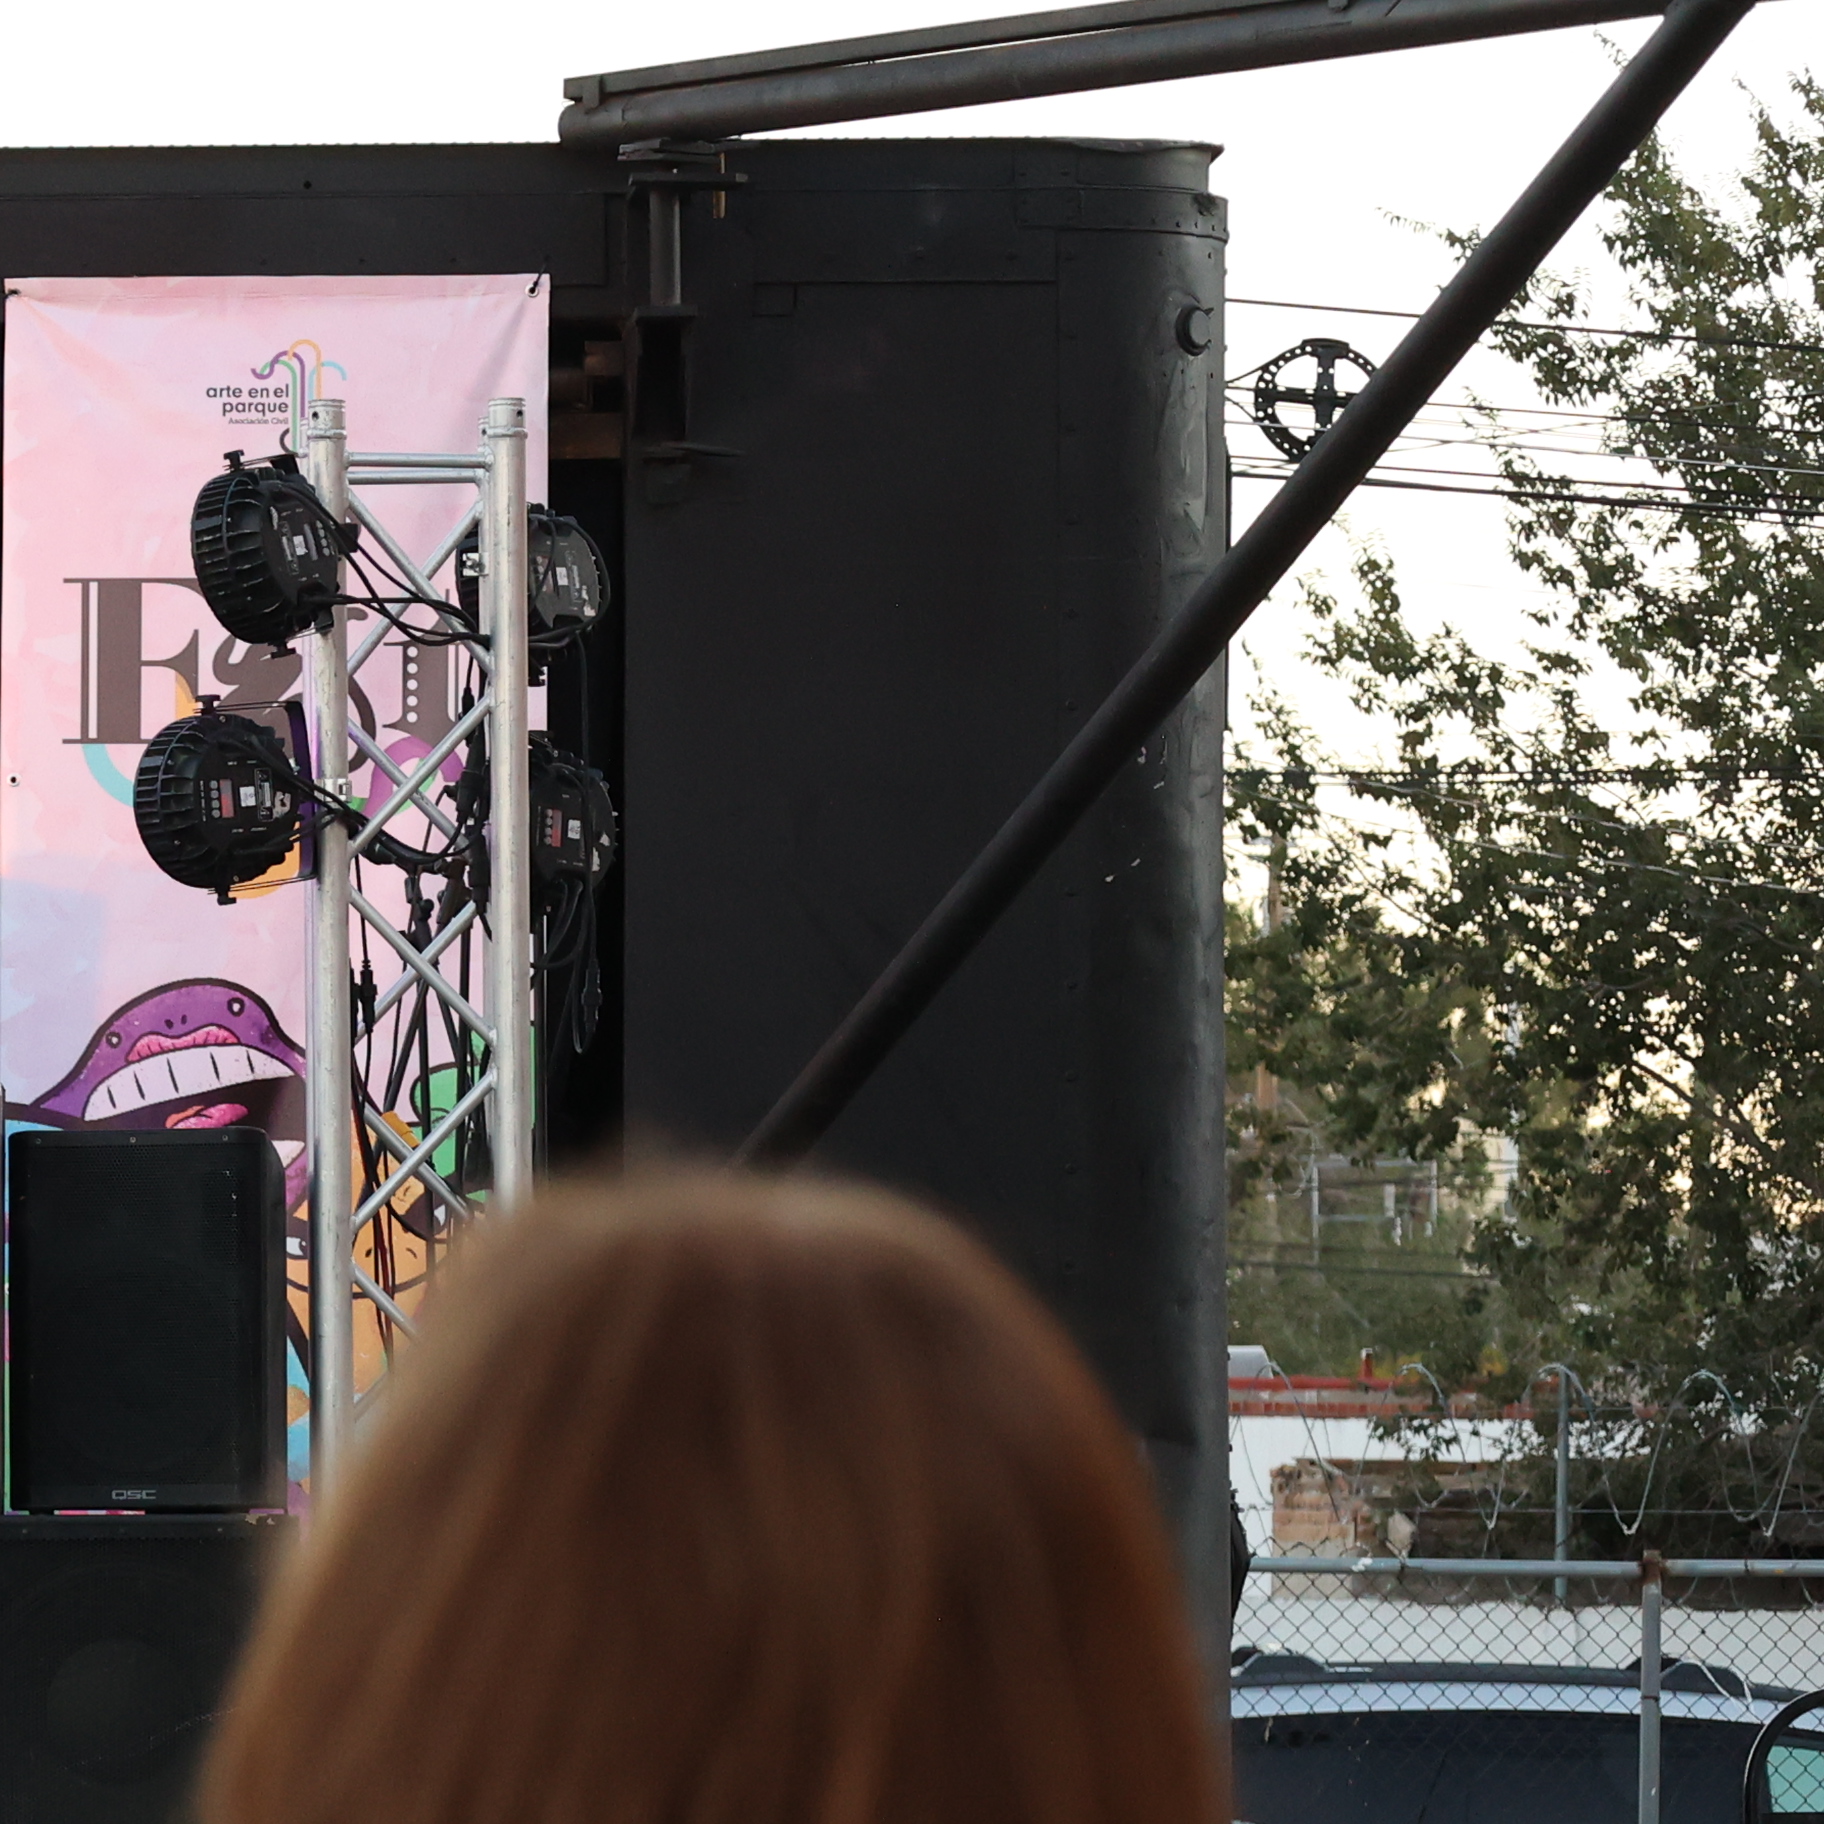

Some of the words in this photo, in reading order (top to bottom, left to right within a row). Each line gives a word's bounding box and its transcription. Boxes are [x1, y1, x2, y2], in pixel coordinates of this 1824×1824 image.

[206, 385, 243, 399] arte
[248, 387, 270, 399] en
[273, 383, 289, 399] el
[222, 401, 289, 417] parque
[112, 1489, 157, 1500] QSC
